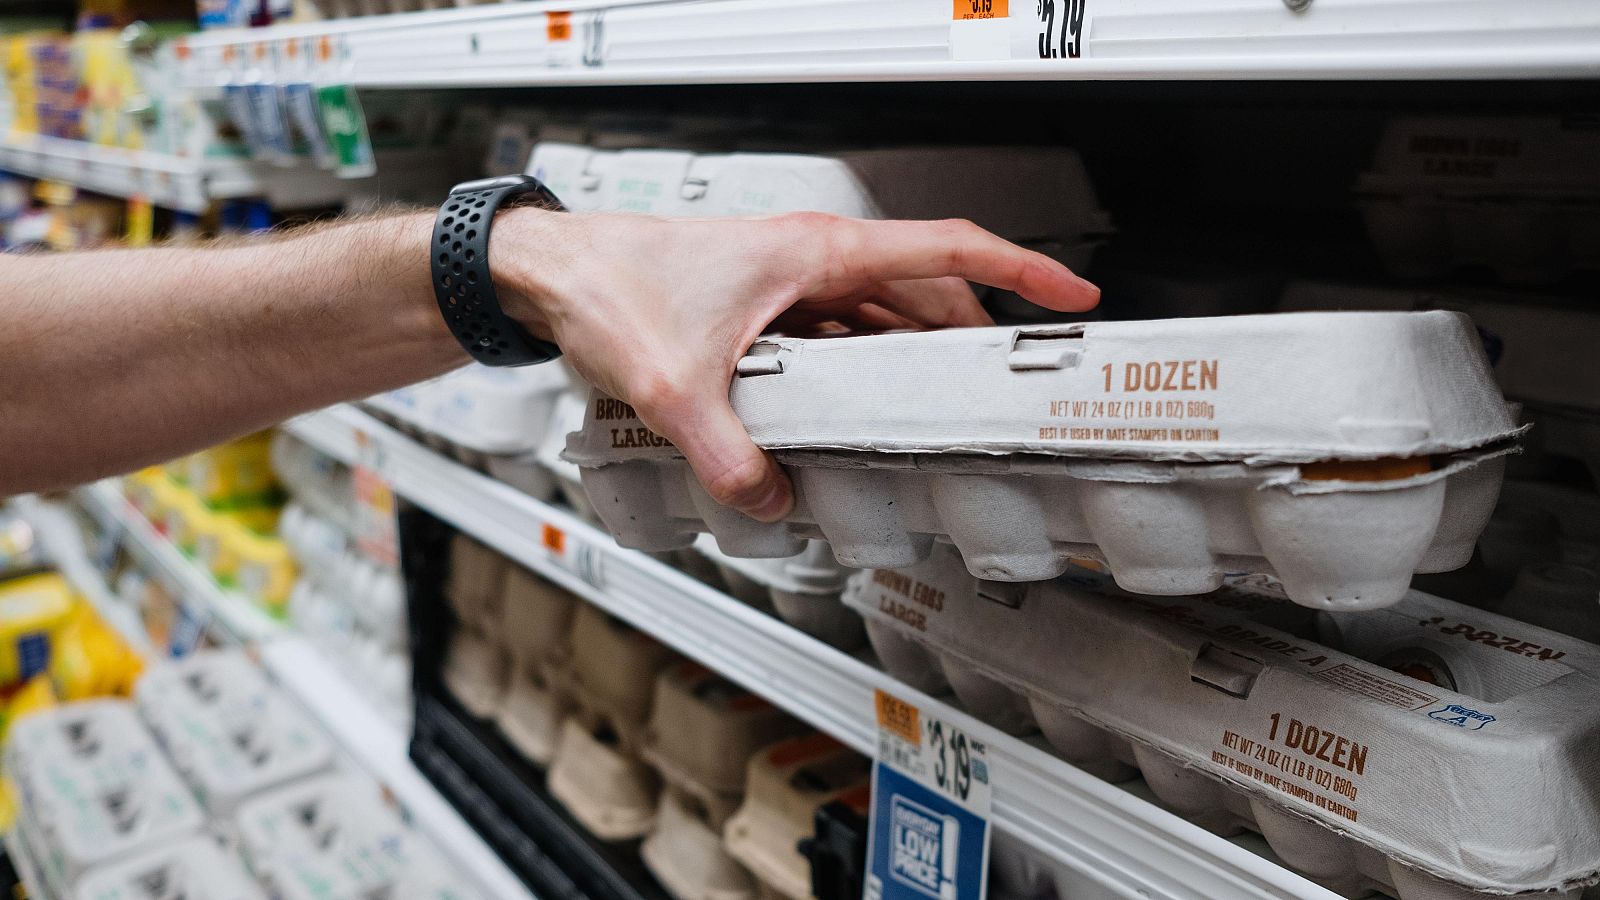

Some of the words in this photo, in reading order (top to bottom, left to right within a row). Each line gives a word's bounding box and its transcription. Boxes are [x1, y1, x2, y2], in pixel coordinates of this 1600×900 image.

[979, 12, 995, 20] EACH
[1102, 363, 1113, 392] 1
[1124, 360, 1218, 392] DOZEN
[595, 398, 639, 420] BROW
[1050, 401, 1069, 418] NET
[1072, 401, 1088, 418] WT
[1091, 401, 1104, 418] 24
[1107, 401, 1121, 418] OZ
[1124, 401, 1134, 420] (1
[1138, 401, 1152, 418] LB
[1155, 401, 1162, 418] 8
[1166, 401, 1184, 419] OZ)
[1187, 401, 1215, 420] 680g
[1039, 428, 1057, 440] BEST
[1060, 428, 1067, 440] IF
[1070, 428, 1090, 440] USED
[1093, 428, 1104, 440] BY
[1106, 428, 1126, 440] DATE
[1129, 428, 1167, 440] STAMPED
[1170, 428, 1182, 440] ON
[1185, 428, 1219, 440] CARTON
[880, 594, 928, 632] LARGE
[1215, 625, 1307, 656] GRADE
[1298, 654, 1328, 667] A
[1440, 623, 1567, 660] DOZEN
[928, 719, 970, 802] $3.19
[971, 739, 985, 755] WIC
[1269, 713, 1280, 740] 1
[1285, 718, 1368, 776] DOZEN
[1222, 730, 1240, 750] NET
[1240, 737, 1255, 756] WT
[1254, 743, 1267, 761] 24
[1269, 749, 1282, 768] OZ
[1281, 755, 1290, 772] (1
[1292, 759, 1306, 778] LB
[1307, 765, 1314, 780] 8
[1315, 768, 1332, 790] OZ)
[1333, 776, 1357, 801] 680g
[1212, 750, 1227, 766] BEST
[1228, 757, 1235, 769] IF
[1236, 761, 1253, 777] USED
[1254, 767, 1263, 781] BY
[1264, 771, 1282, 789] DATE
[1282, 781, 1314, 803] STAMPED
[1316, 795, 1326, 809] ON
[1328, 800, 1358, 822] CARTON
[896, 825, 939, 864] LOW
[895, 850, 939, 889] PRICE
